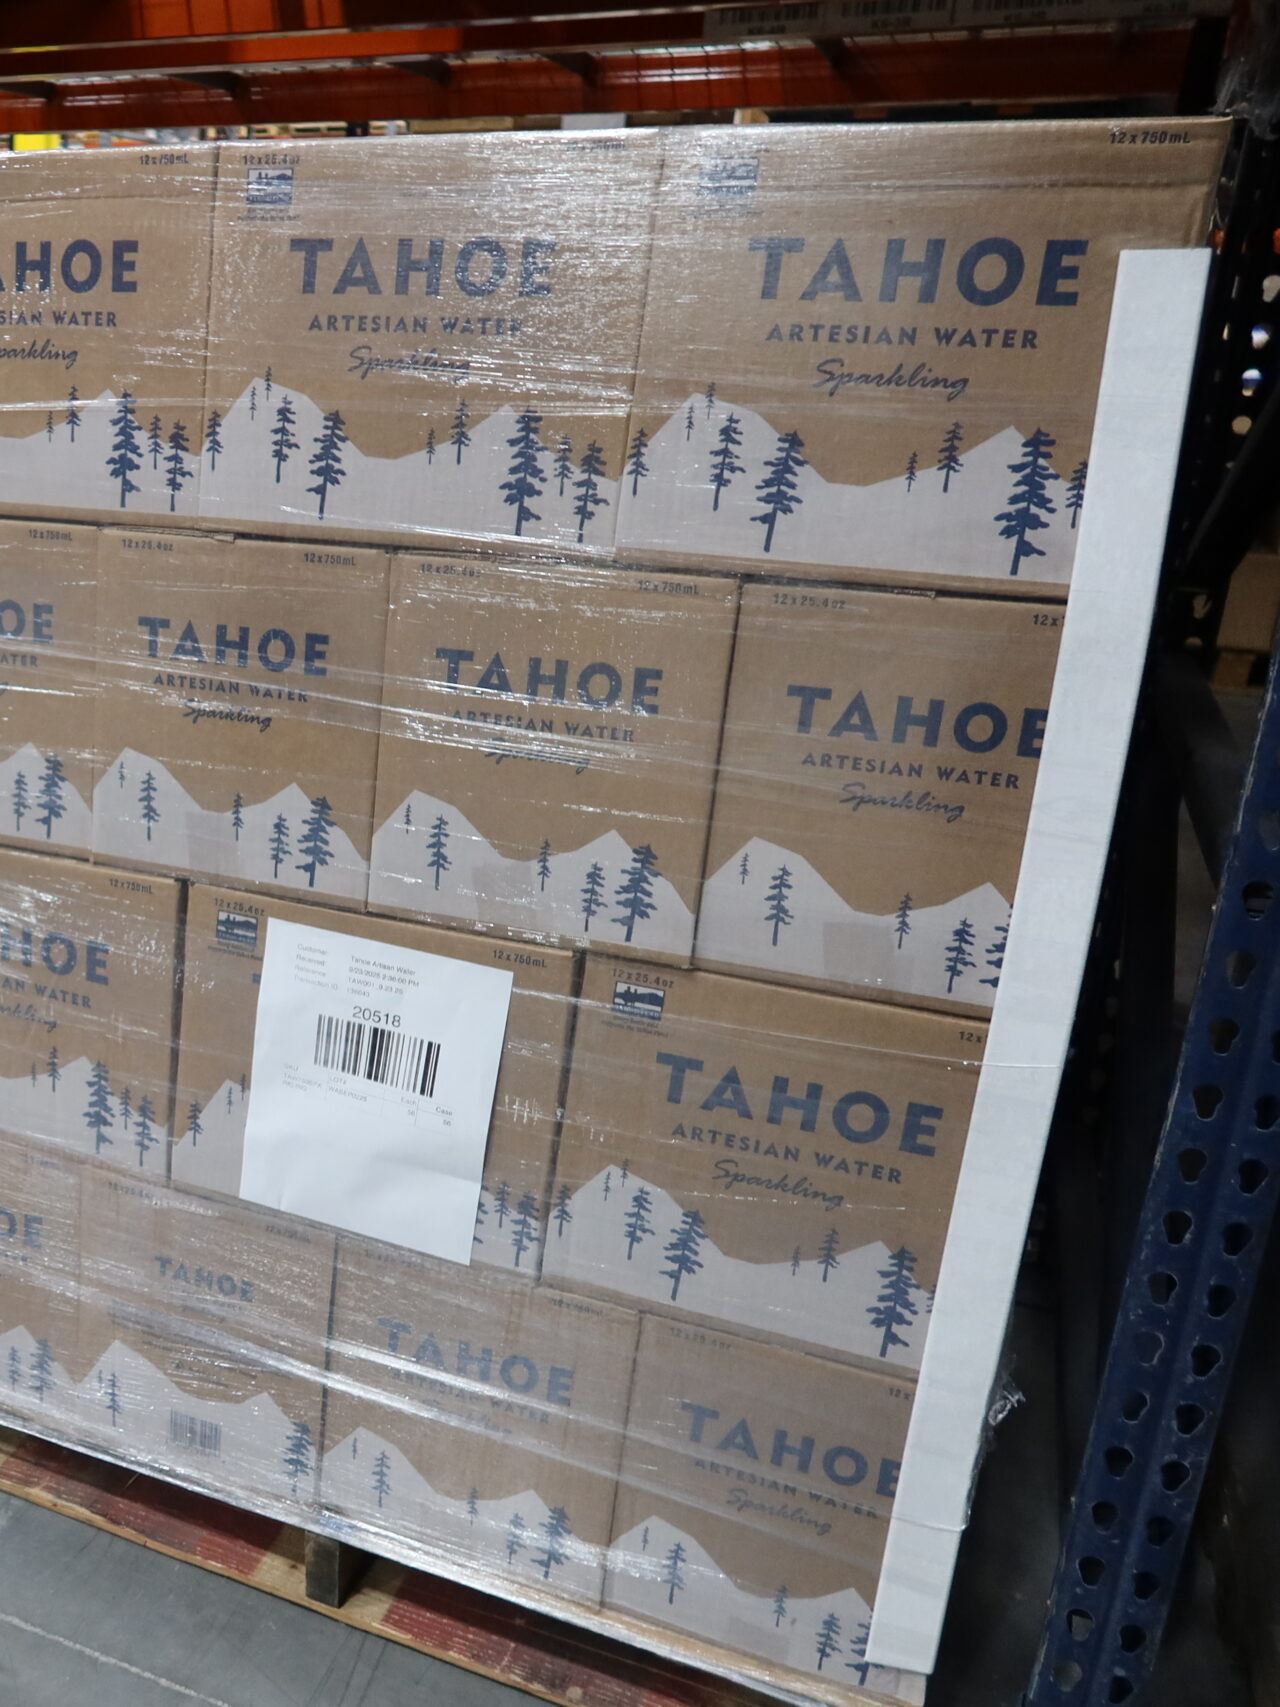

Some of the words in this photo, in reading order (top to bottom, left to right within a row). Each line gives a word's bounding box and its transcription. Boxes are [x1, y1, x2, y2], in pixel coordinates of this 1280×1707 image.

[290, 236, 556, 298] TAHOE
[748, 236, 1089, 306] TAHOE
[52, 311, 117, 327] WATER
[308, 314, 427, 333] ARTESIAN
[440, 316, 522, 336] WATER
[765, 324, 918, 346] ARTESIAN
[934, 326, 1038, 349] WATER
[813, 358, 970, 399] Sparkling
[138, 616, 331, 677] TAHOE
[154, 673, 240, 695] ARTESIAN
[248, 683, 308, 704] WATER
[435, 647, 664, 715] TAHOE
[452, 709, 553, 733] ARTESIAN
[564, 721, 635, 743] WATER
[787, 684, 1048, 758] TAHOE
[801, 751, 924, 779] ARTESIAN
[936, 766, 1020, 790] WATER
[839, 782, 966, 823] Sparkling
[35, 984, 92, 1009] WATER
[352, 1005, 402, 1028] 20518
[656, 1050, 944, 1158] TAHOE
[671, 1122, 800, 1162] ARTESIAN
[814, 1151, 903, 1184] WATER
[712, 1159, 845, 1211] Sparkling
[155, 1255, 255, 1303] TAHOE
[377, 1317, 575, 1407] TAHOE
[695, 1457, 797, 1498] ARTESIAN
[809, 1486, 878, 1519] WATER
[726, 1487, 832, 1536] Sparkling
